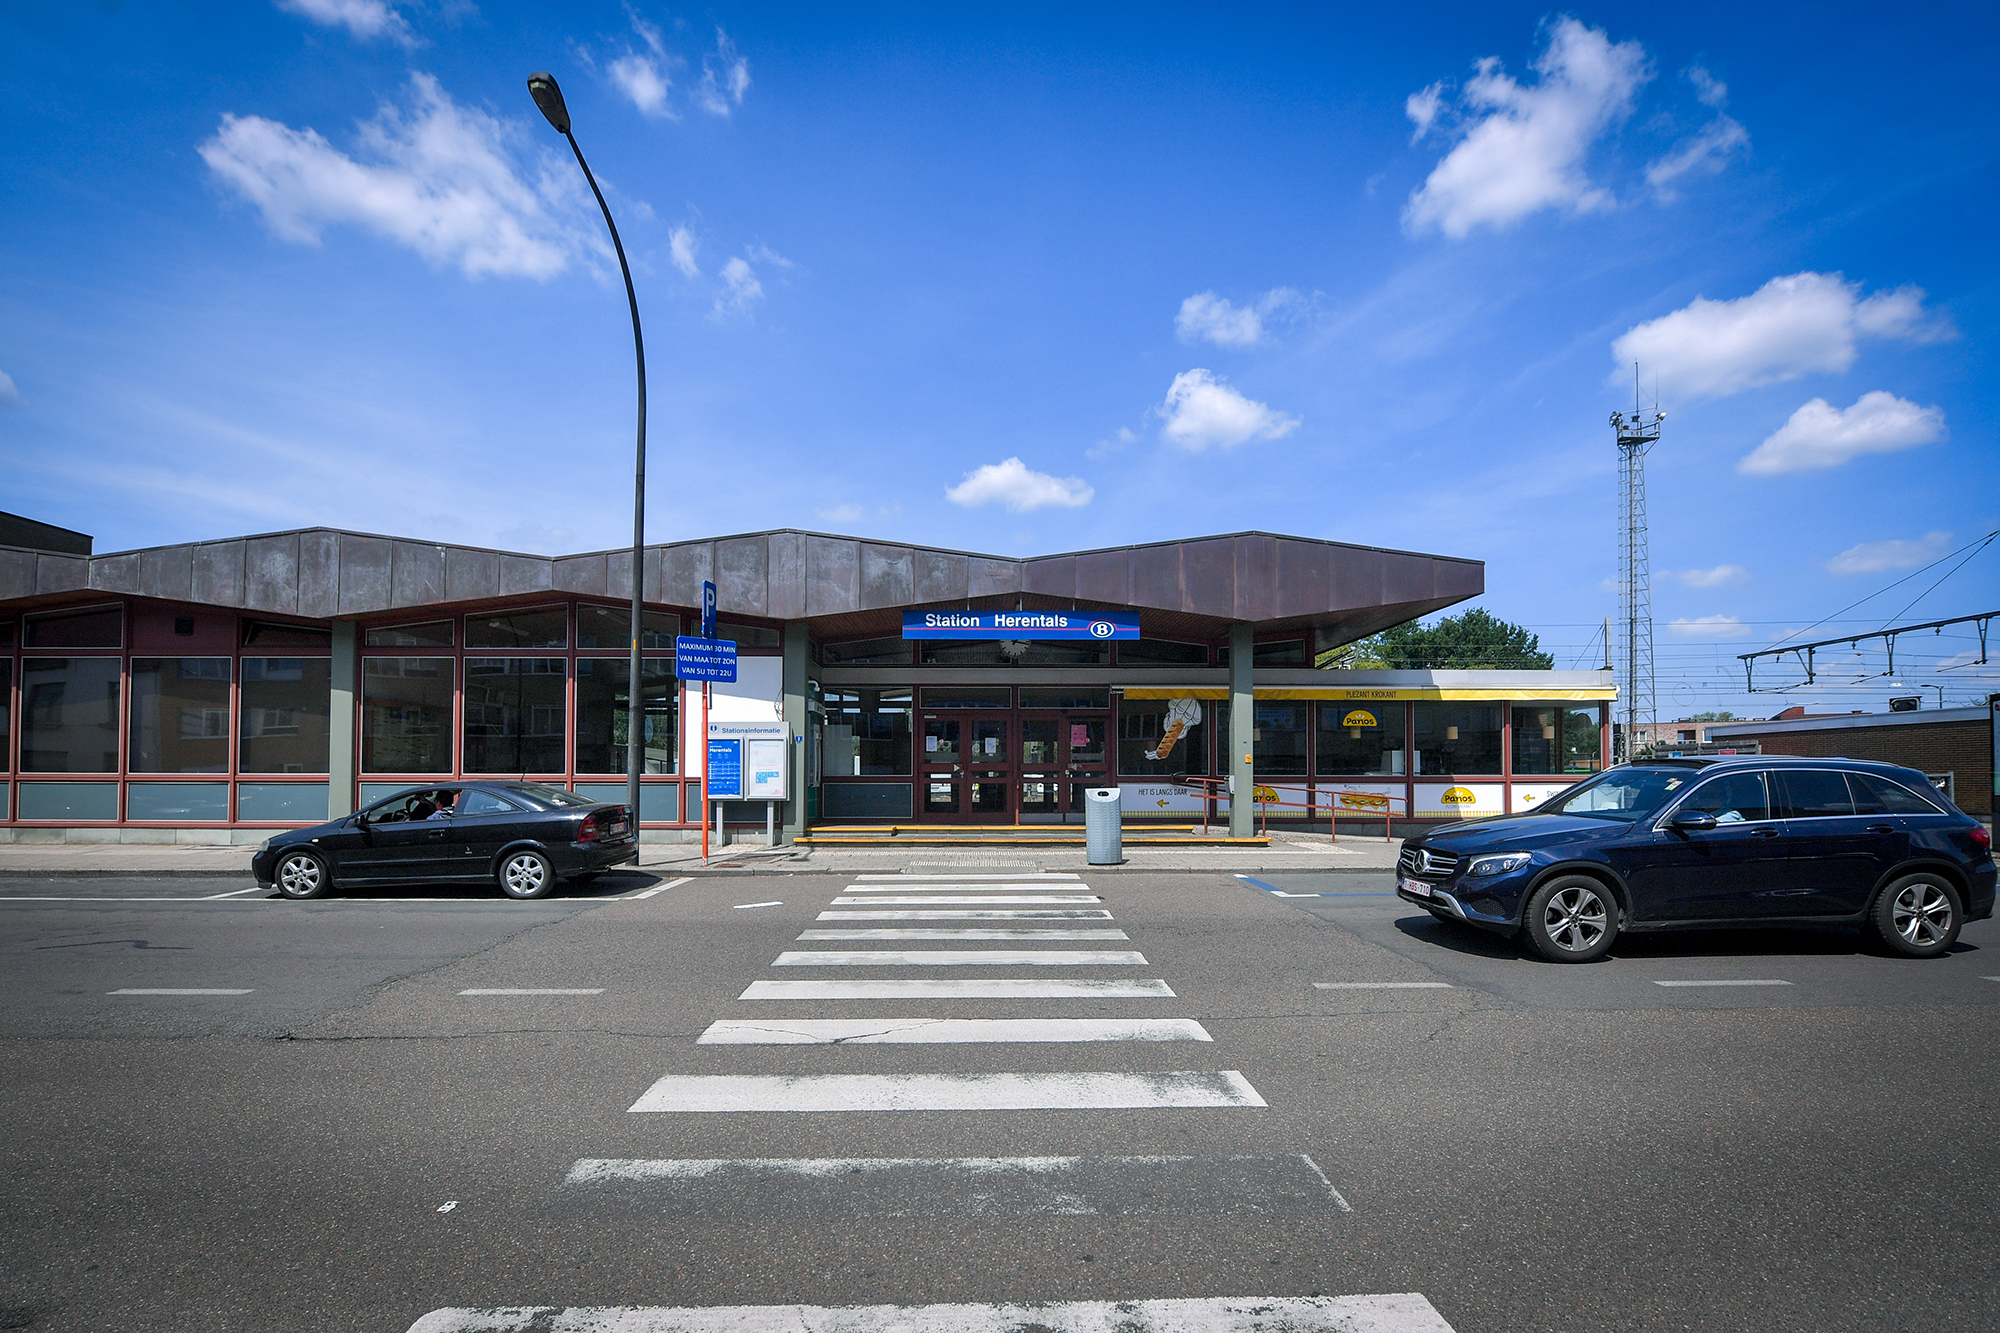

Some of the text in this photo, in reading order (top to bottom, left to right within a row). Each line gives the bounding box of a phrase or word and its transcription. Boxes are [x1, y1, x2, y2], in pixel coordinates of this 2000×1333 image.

[706, 587, 715, 617] P
[925, 613, 1068, 628] Station Herentals
[1096, 624, 1109, 636] B
[679, 642, 713, 652] MAXIMUM
[714, 645, 722, 653] 30
[679, 654, 693, 662] VAN
[682, 666, 695, 674] VAN
[707, 668, 719, 676] TOT
[720, 669, 732, 677] 22U
[1346, 690, 1397, 698] PLEZANT KROKANT
[1346, 717, 1374, 725] Panos
[1138, 788, 1149, 796] HET
[1155, 788, 1173, 796] LANGS
[1174, 788, 1188, 796] DAAR
[1444, 794, 1473, 802] Panos
